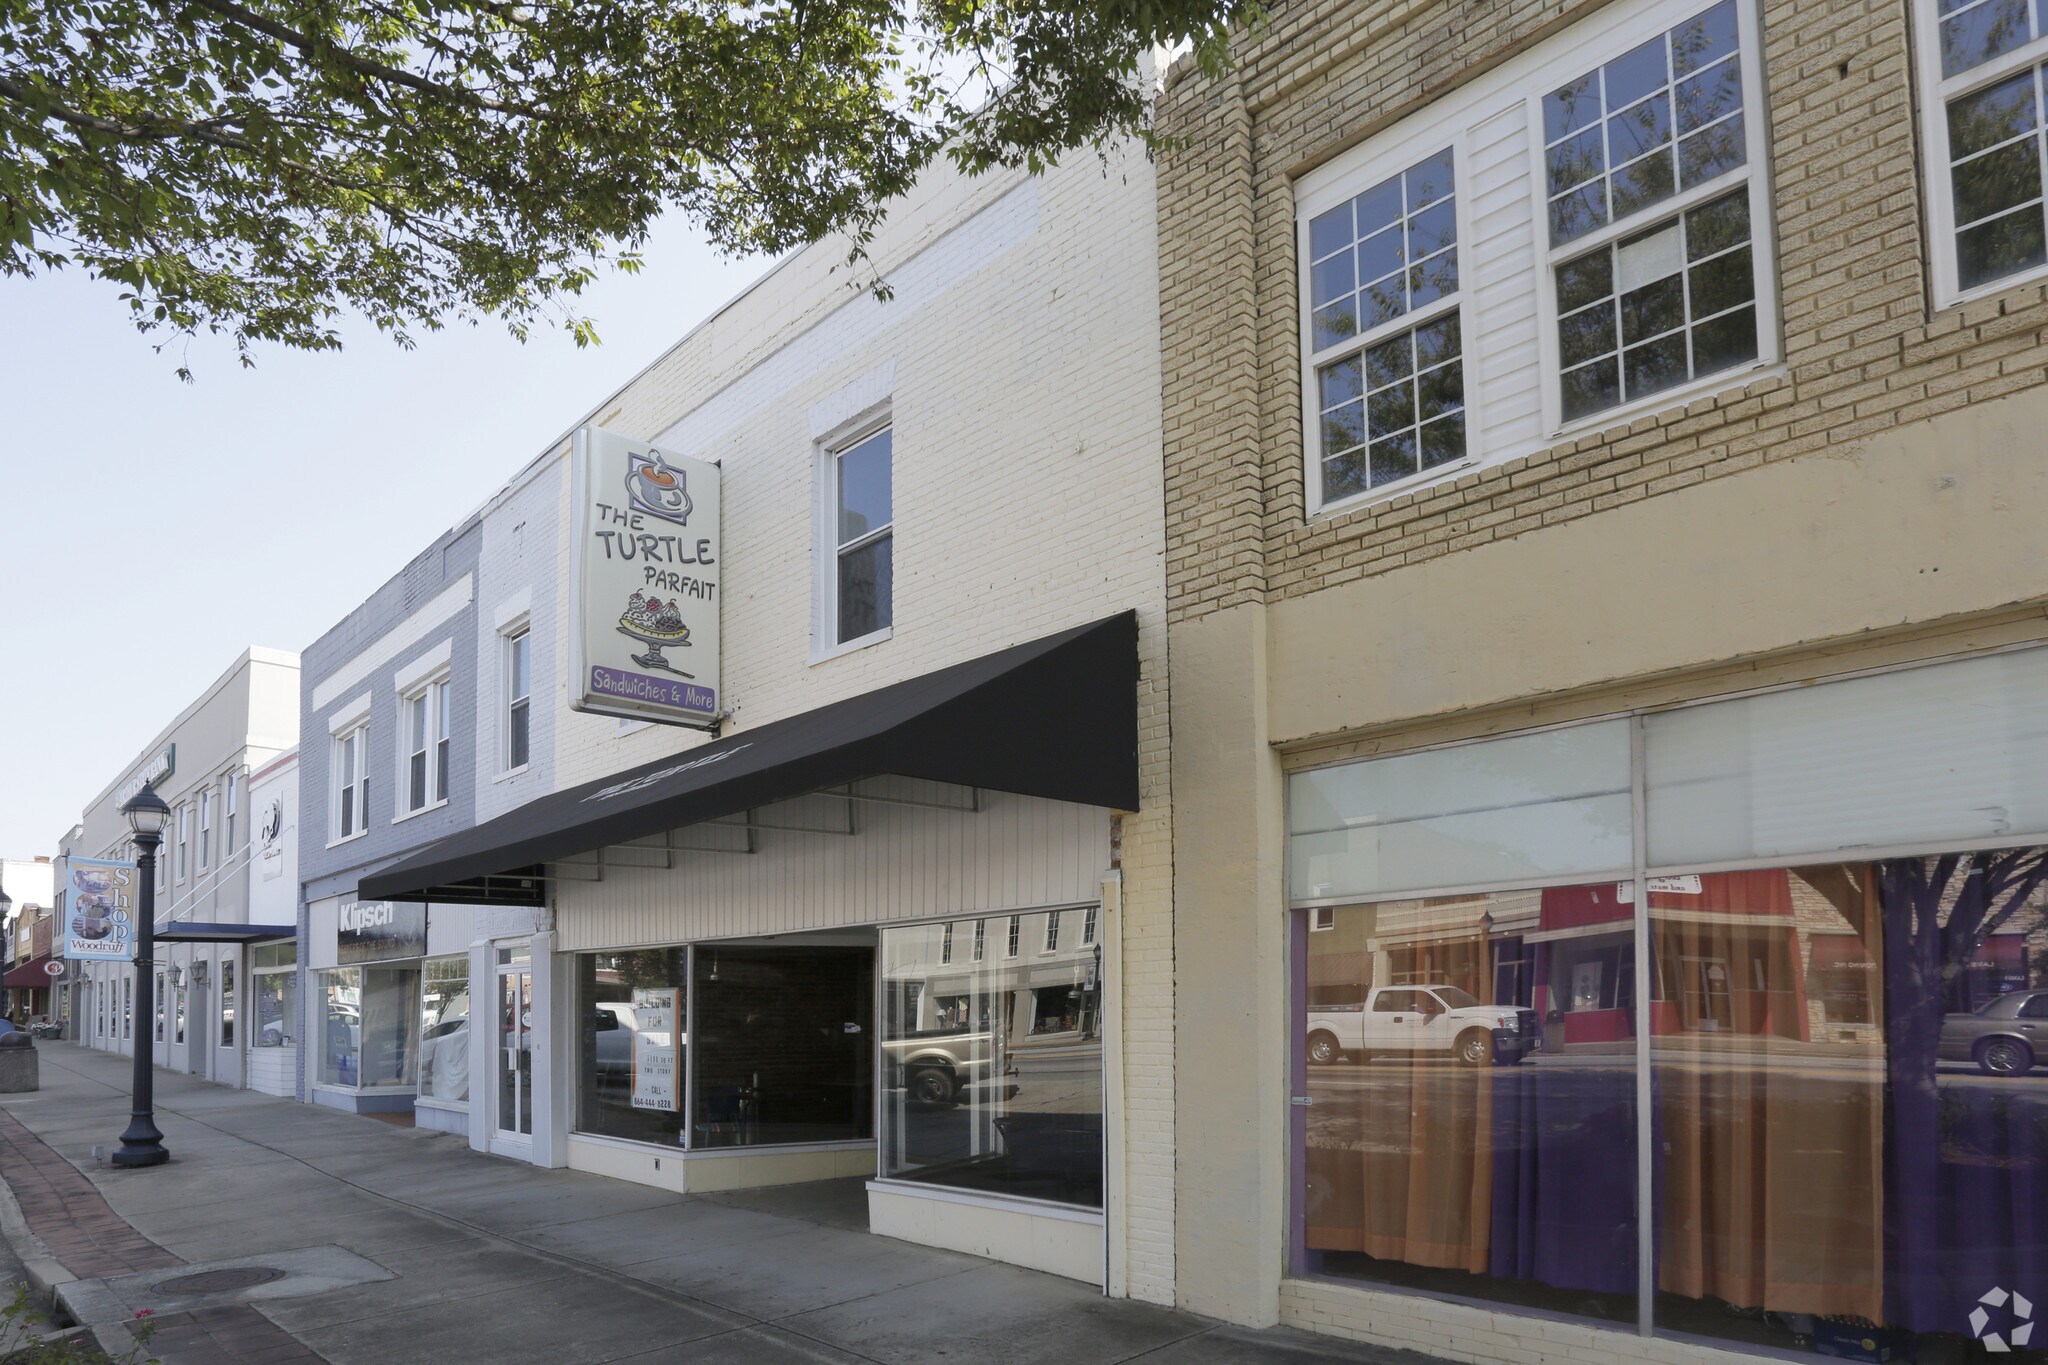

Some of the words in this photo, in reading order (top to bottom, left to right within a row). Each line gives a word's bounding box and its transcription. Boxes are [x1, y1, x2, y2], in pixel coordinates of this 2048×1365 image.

[596, 503, 644, 530] THE
[595, 530, 715, 565] TURTLE
[644, 566, 716, 601] PARFAIT
[593, 668, 667, 702] Sandwiches
[671, 685, 681, 703] &
[685, 686, 713, 709] More
[112, 868, 131, 943] Shop
[340, 901, 393, 935] Klipsch
[72, 940, 126, 954] Woodruff
[647, 1016, 663, 1028] FOR
[651, 1086, 662, 1095] CALL
